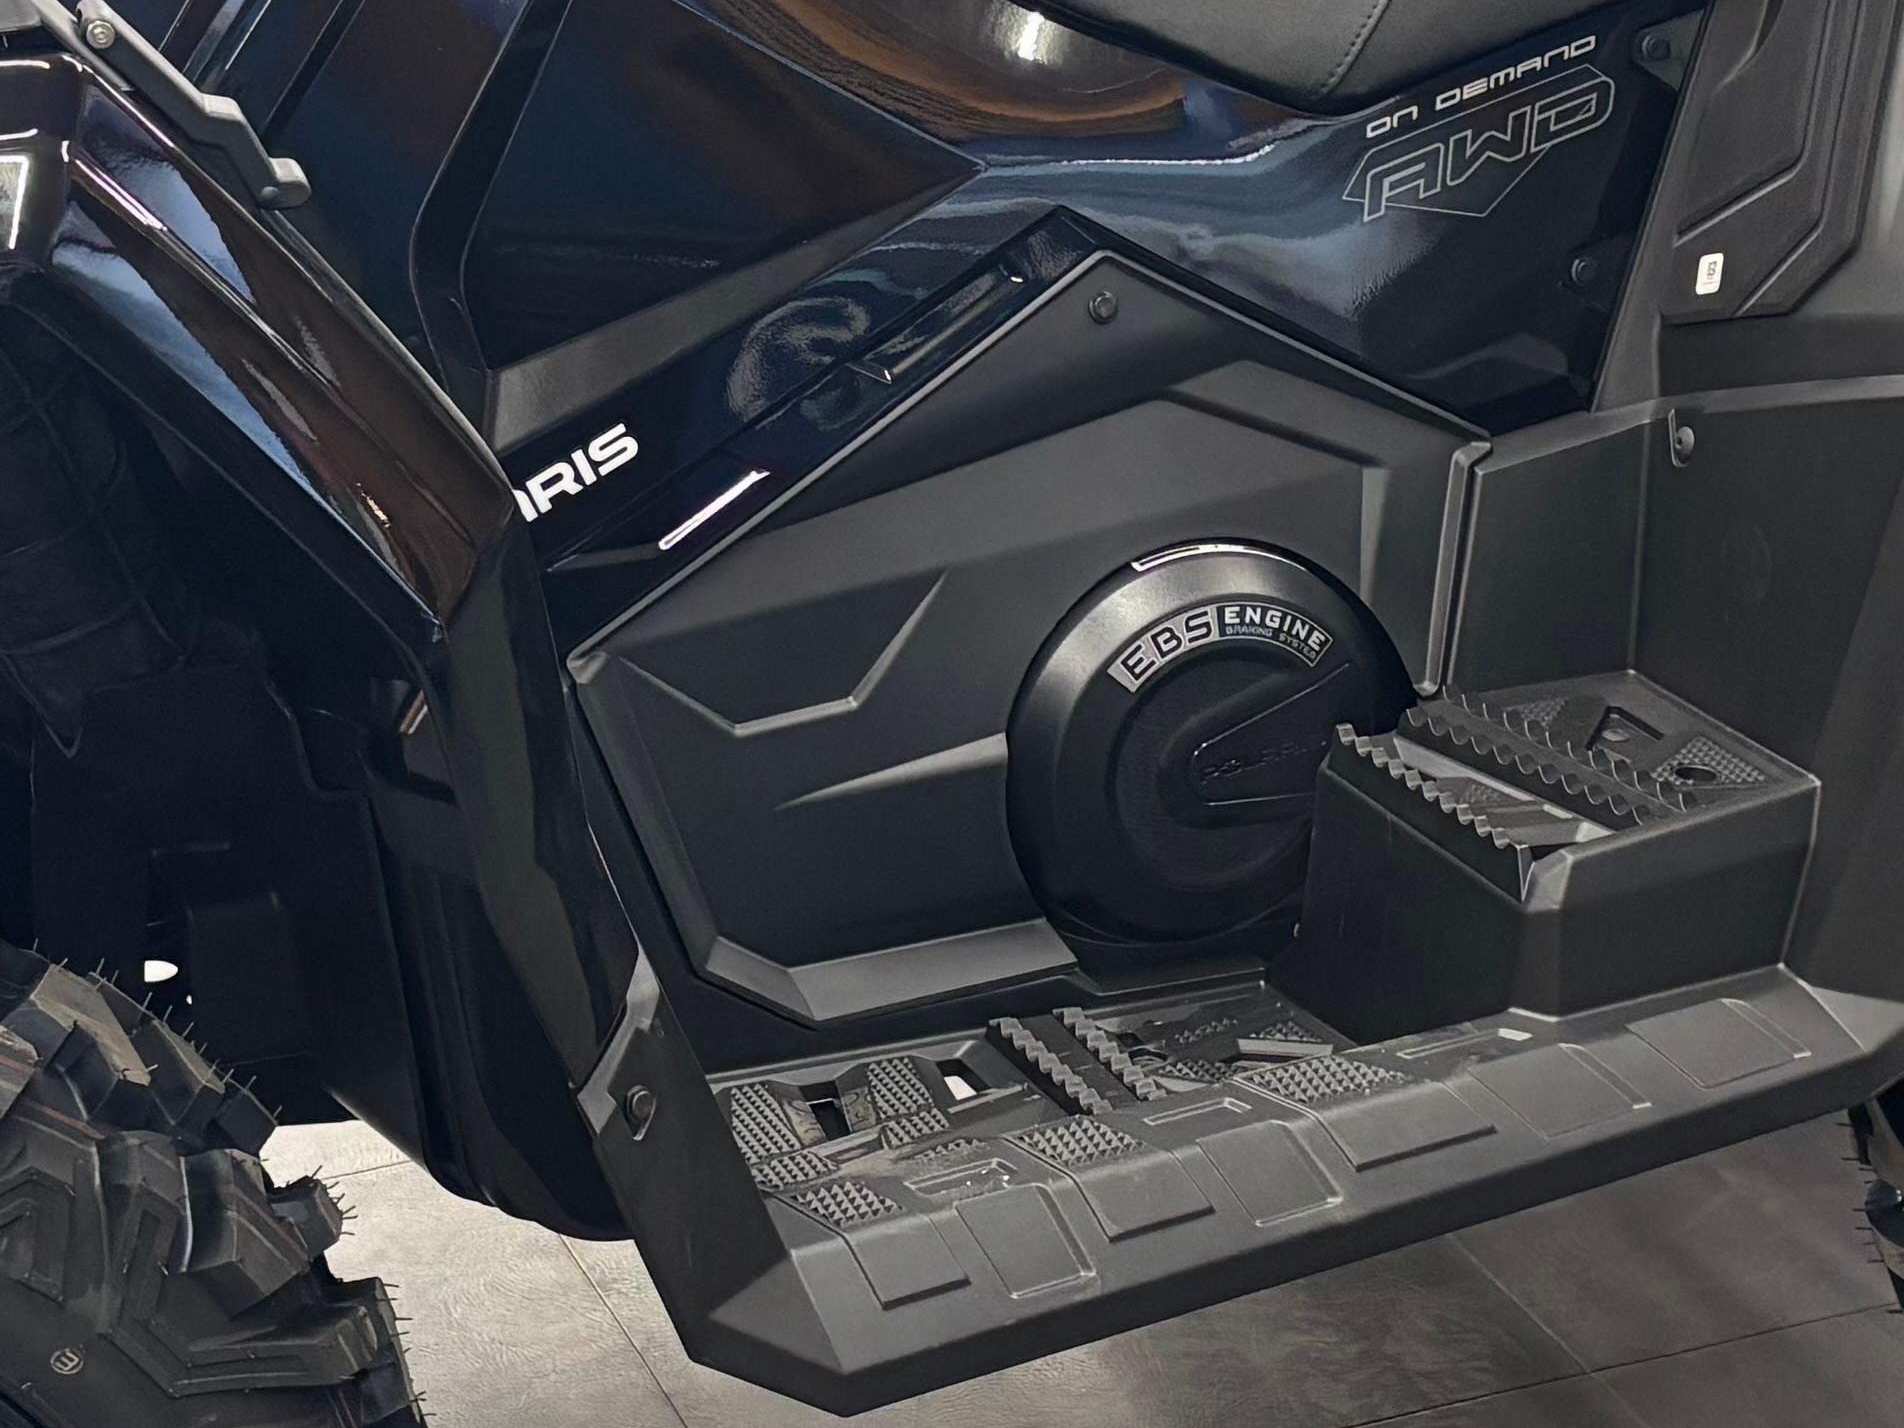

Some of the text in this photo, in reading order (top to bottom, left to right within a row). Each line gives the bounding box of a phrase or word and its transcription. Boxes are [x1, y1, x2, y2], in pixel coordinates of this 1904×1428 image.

[1366, 34, 1597, 139] ON DEMAND
[1362, 75, 1616, 224] AWD
[1119, 605, 1327, 682] EBS ENGINE
[1225, 623, 1274, 638] BRAKING
